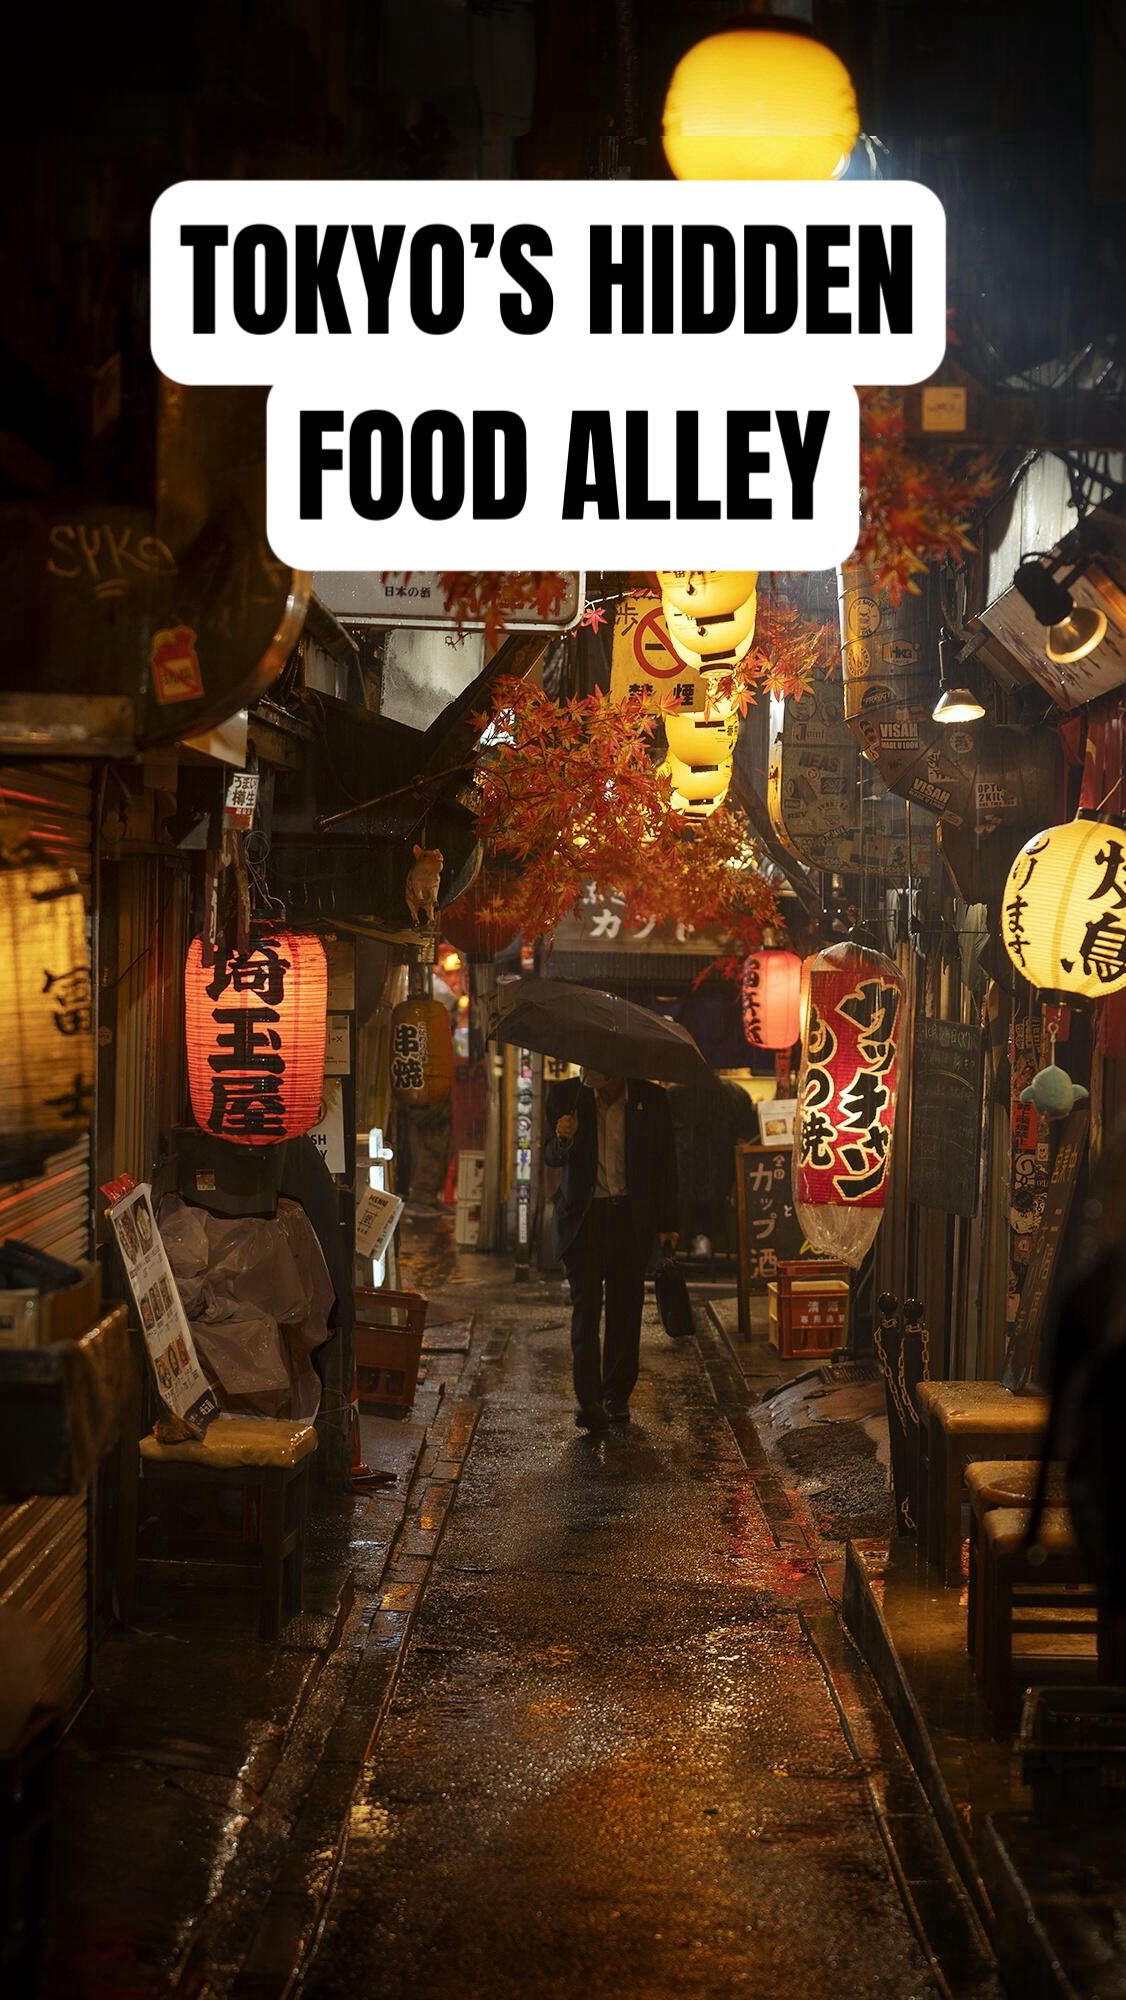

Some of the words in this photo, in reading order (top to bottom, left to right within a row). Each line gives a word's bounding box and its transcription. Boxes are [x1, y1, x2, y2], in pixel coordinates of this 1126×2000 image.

[385, 585, 431, 598] 日本の酒
[394, 1023, 424, 1090] 串焼
[750, 1162, 778, 1280] カップ酒
